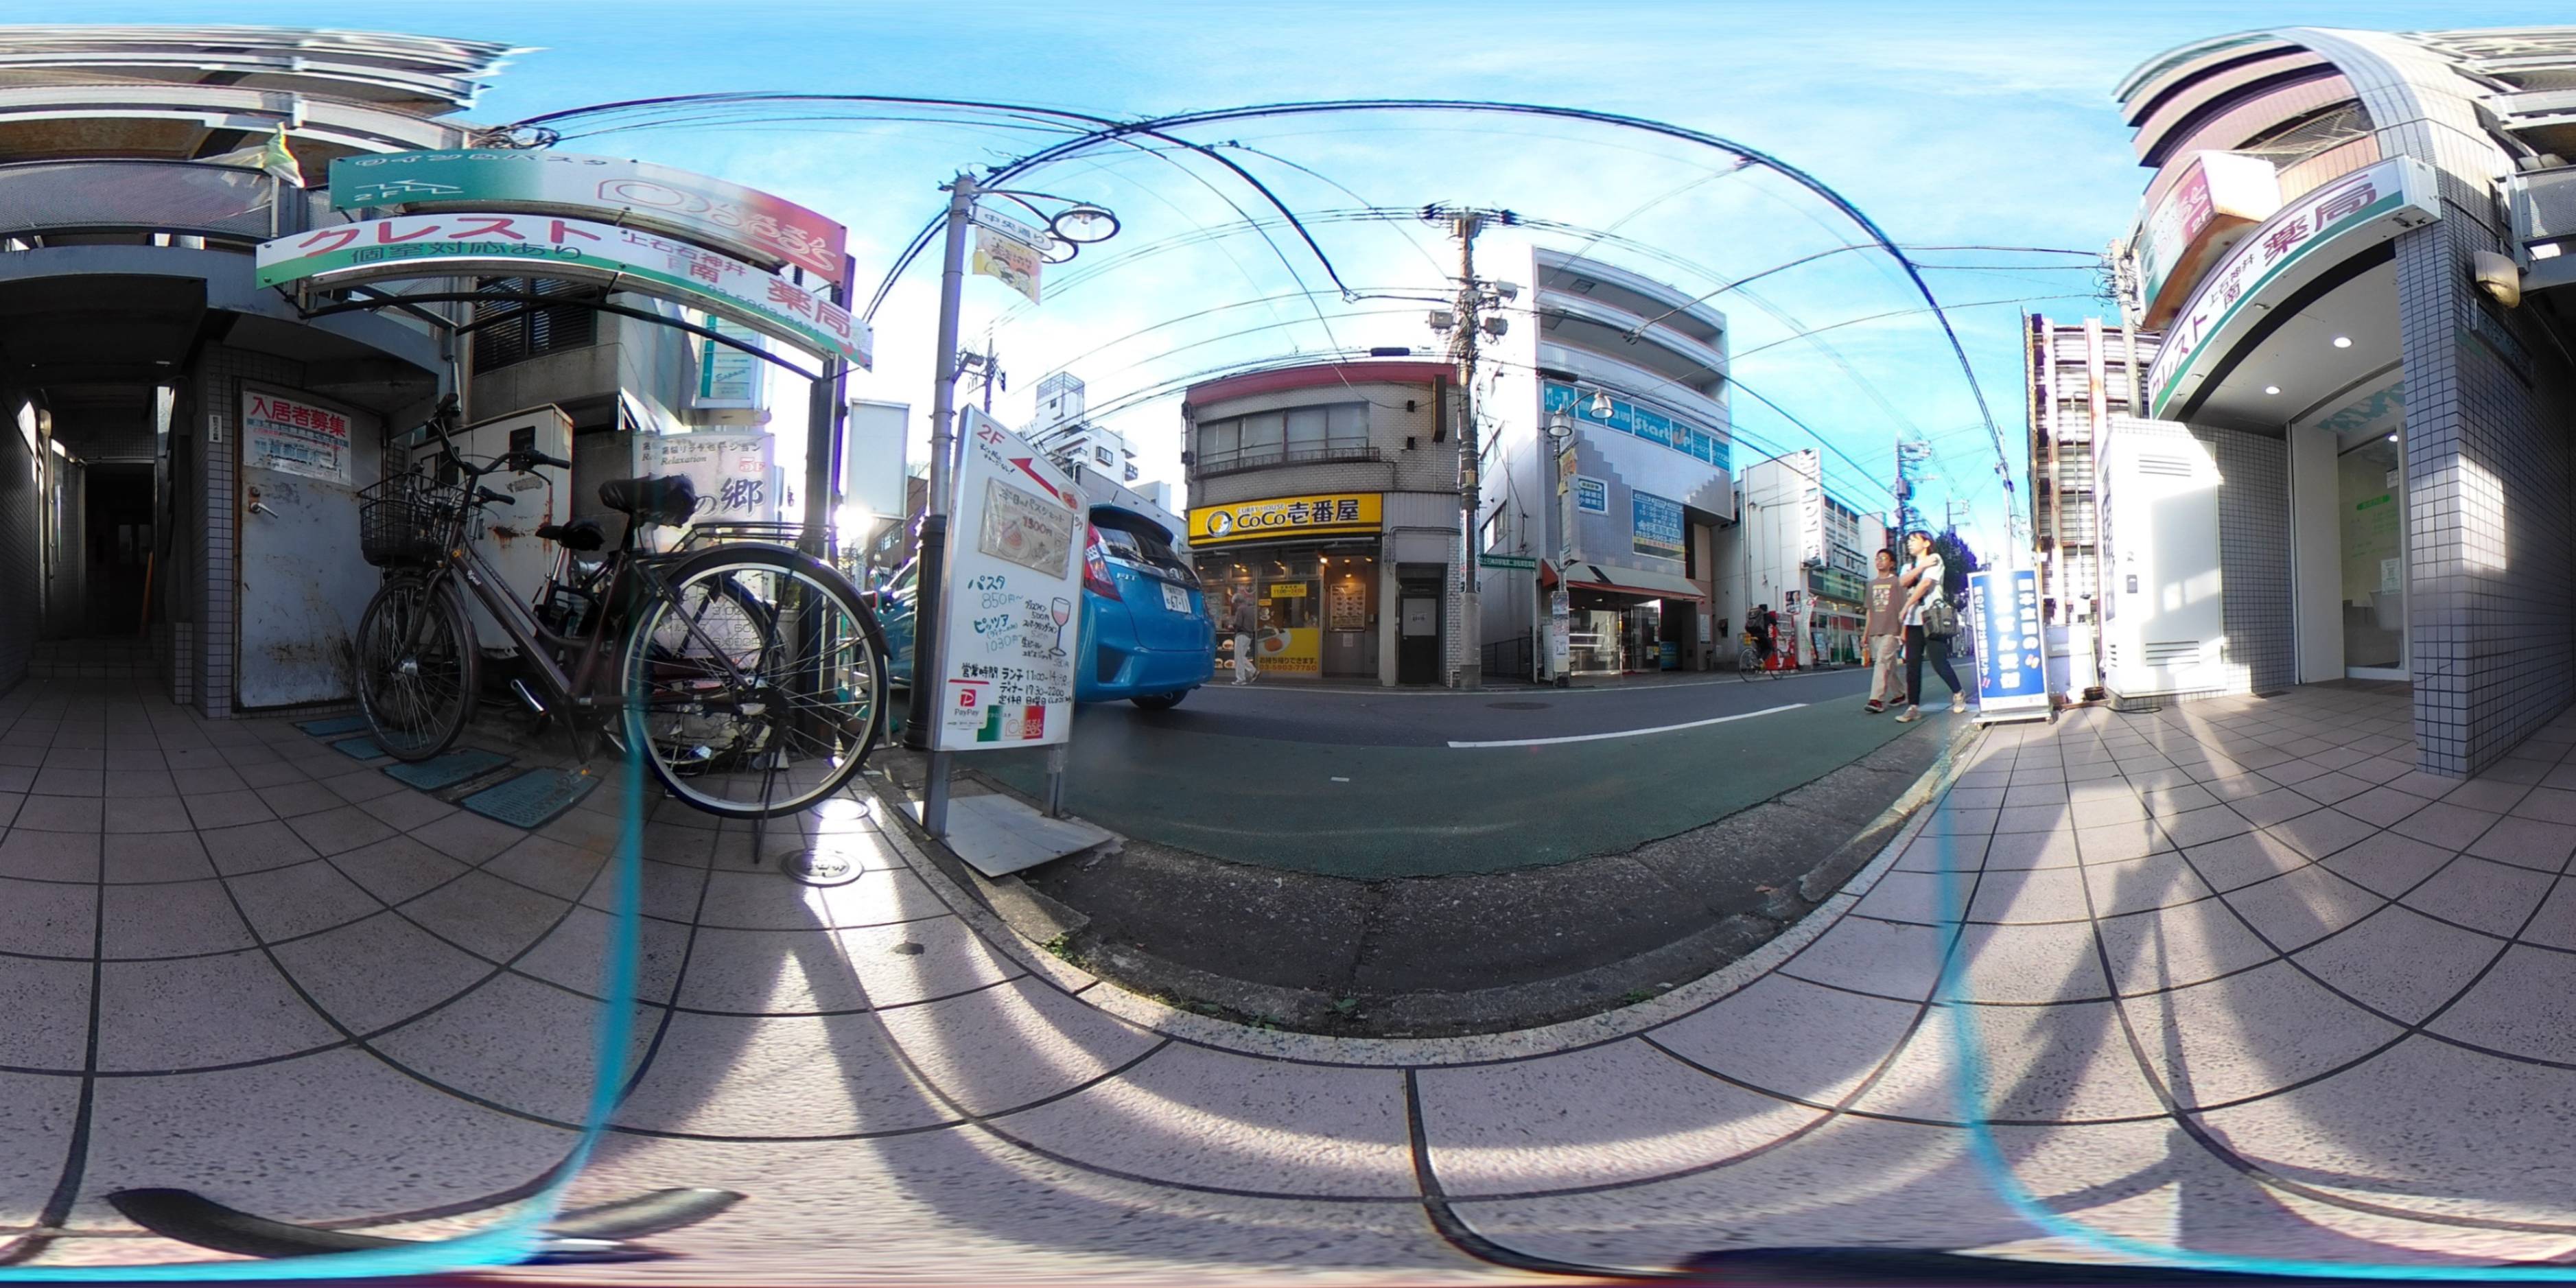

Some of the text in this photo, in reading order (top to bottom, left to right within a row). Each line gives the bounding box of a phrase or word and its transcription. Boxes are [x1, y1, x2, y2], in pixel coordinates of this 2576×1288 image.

[354, 189, 398, 202] 2F
[2263, 181, 2377, 268] 薬局
[297, 217, 603, 258] クレスト
[351, 240, 582, 264] 個室対応あり
[766, 276, 852, 339] 薬局
[251, 396, 346, 438] 入居者募集
[976, 423, 1005, 445] 2F
[1635, 417, 1670, 441] Start
[660, 456, 707, 466] Relaxation
[738, 456, 766, 473] 5F
[1237, 499, 1359, 528] CoCo壱番屋
[968, 575, 1006, 590] パスタ
[1116, 572, 1137, 581] FIT
[961, 661, 998, 679] 営業時間
[1002, 667, 1024, 682] ランチ
[998, 681, 1023, 694] ディナー
[955, 708, 980, 717] PayPay
